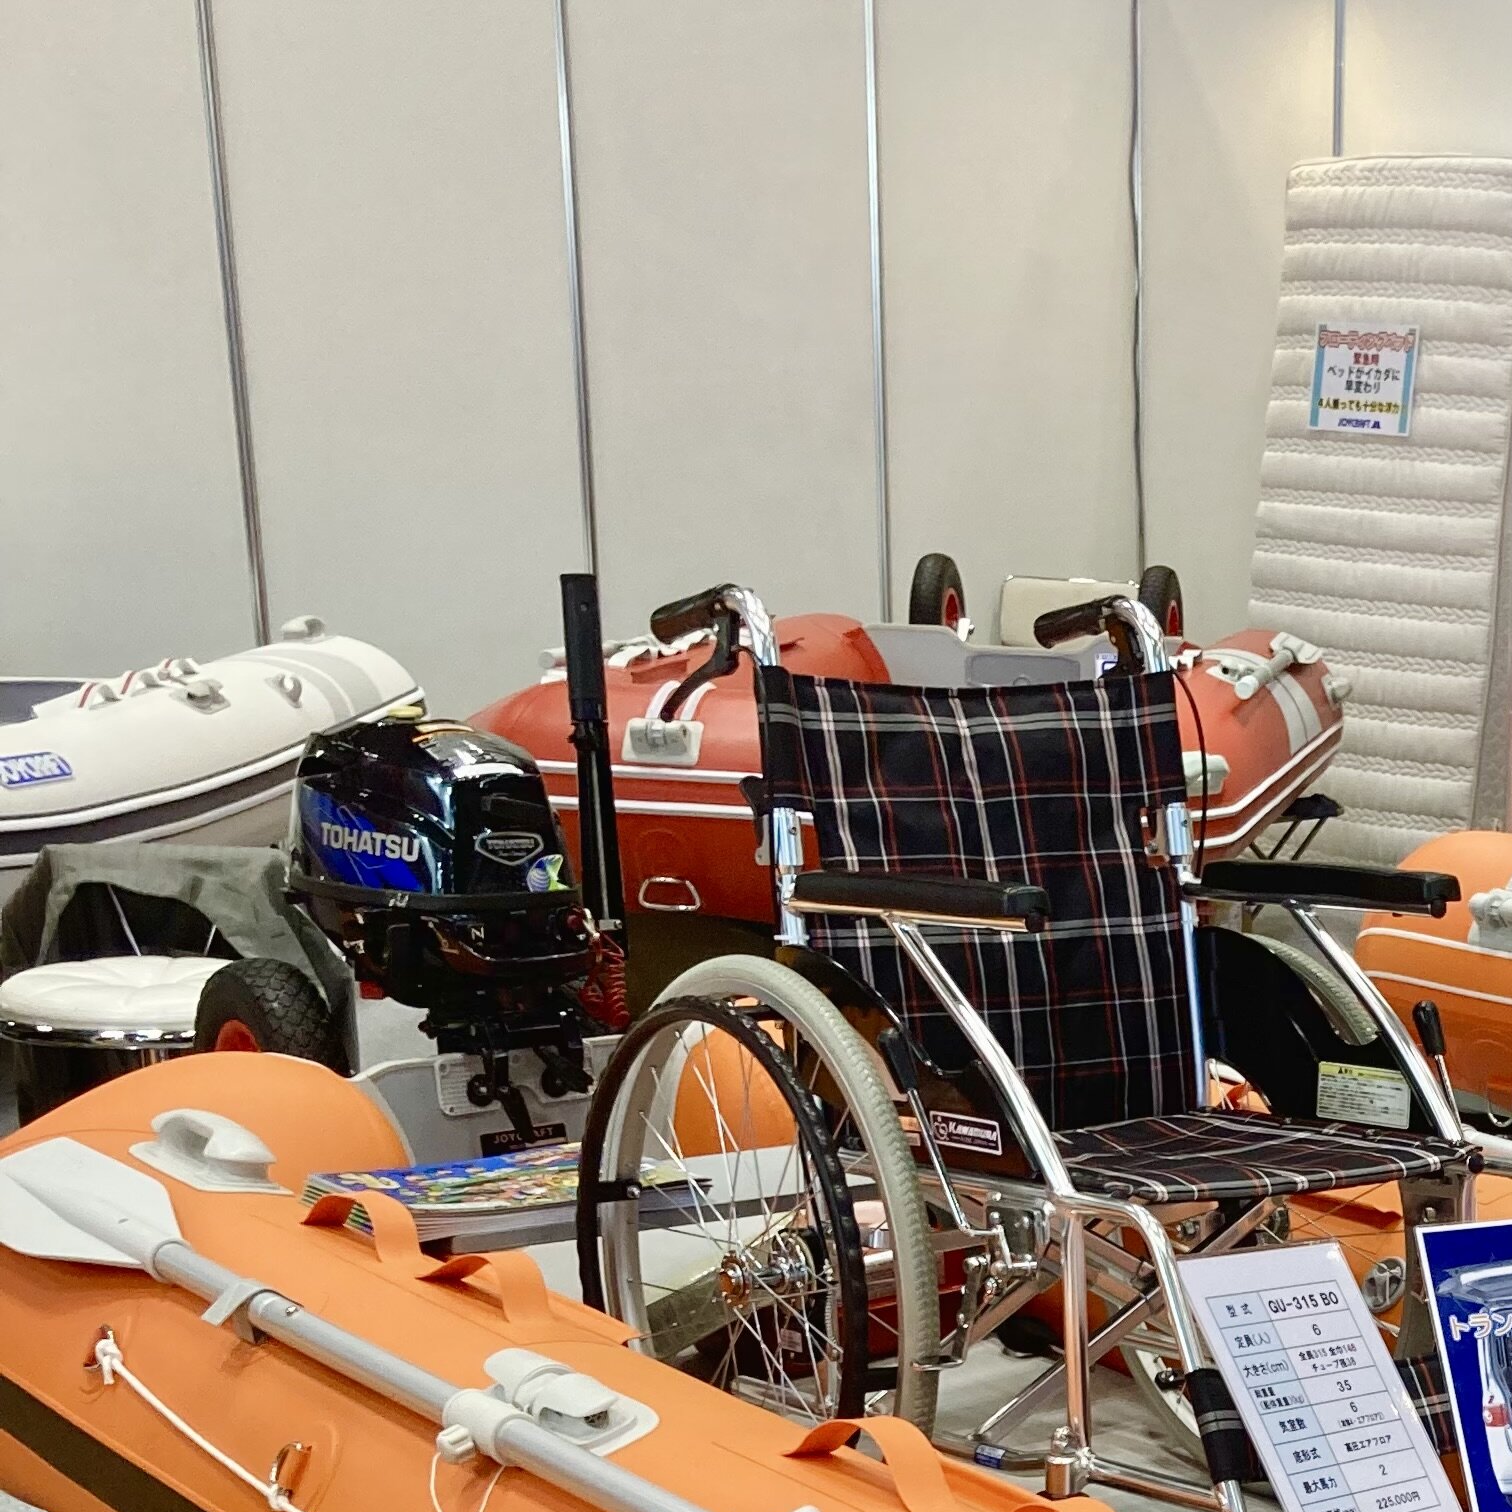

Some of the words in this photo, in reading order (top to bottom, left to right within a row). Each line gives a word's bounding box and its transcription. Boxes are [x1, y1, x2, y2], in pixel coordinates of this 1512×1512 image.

[1327, 365, 1400, 381] ベッドがイカダに
[1344, 380, 1381, 394] 早変わり
[321, 822, 420, 862] TOHATSU
[493, 1127, 553, 1144] JOYCAFT
[1268, 1294, 1318, 1314] GU-315
[1312, 1324, 1321, 1336] 6
[1336, 1379, 1352, 1392] 35
[1349, 1402, 1358, 1413] 6
[1379, 1464, 1388, 1476] 2
